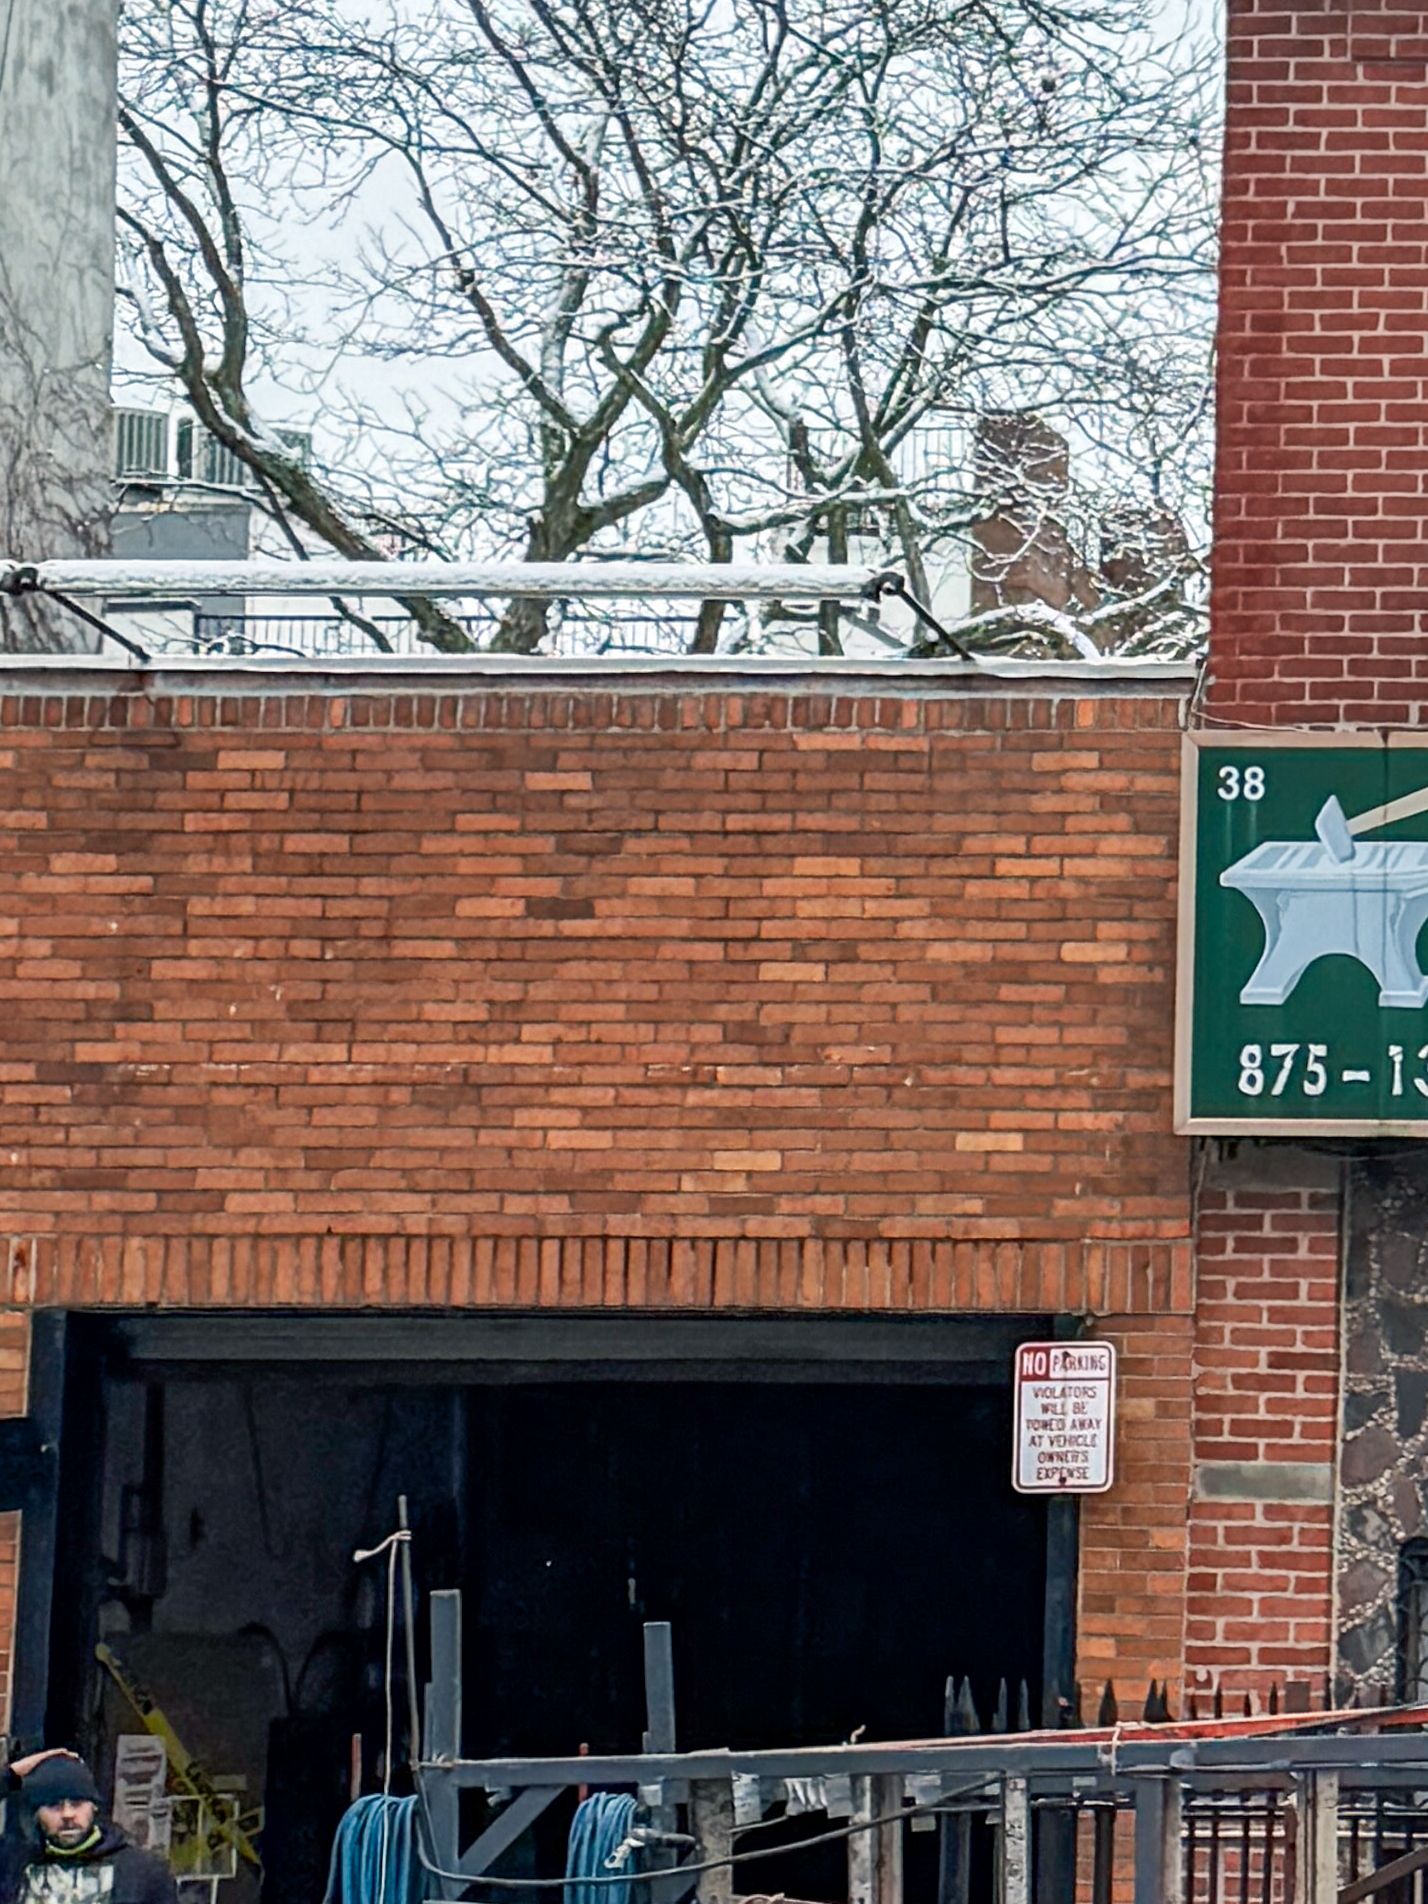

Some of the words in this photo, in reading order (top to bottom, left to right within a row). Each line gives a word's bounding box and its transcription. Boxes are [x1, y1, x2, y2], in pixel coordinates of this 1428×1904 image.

[1217, 766, 1265, 801] 38
[1022, 1352, 1046, 1376] NO
[1053, 1353, 1106, 1372] PARKING
[1033, 1386, 1097, 1399] VIOLATORS
[1041, 1402, 1066, 1415] WILL
[1072, 1402, 1088, 1415] BE
[1026, 1419, 1066, 1431] TOWED
[1070, 1419, 1102, 1430] AWAY
[1029, 1435, 1045, 1447] AT
[1049, 1434, 1097, 1447] VEHICLE
[1036, 1467, 1089, 1480] EXPENSE
